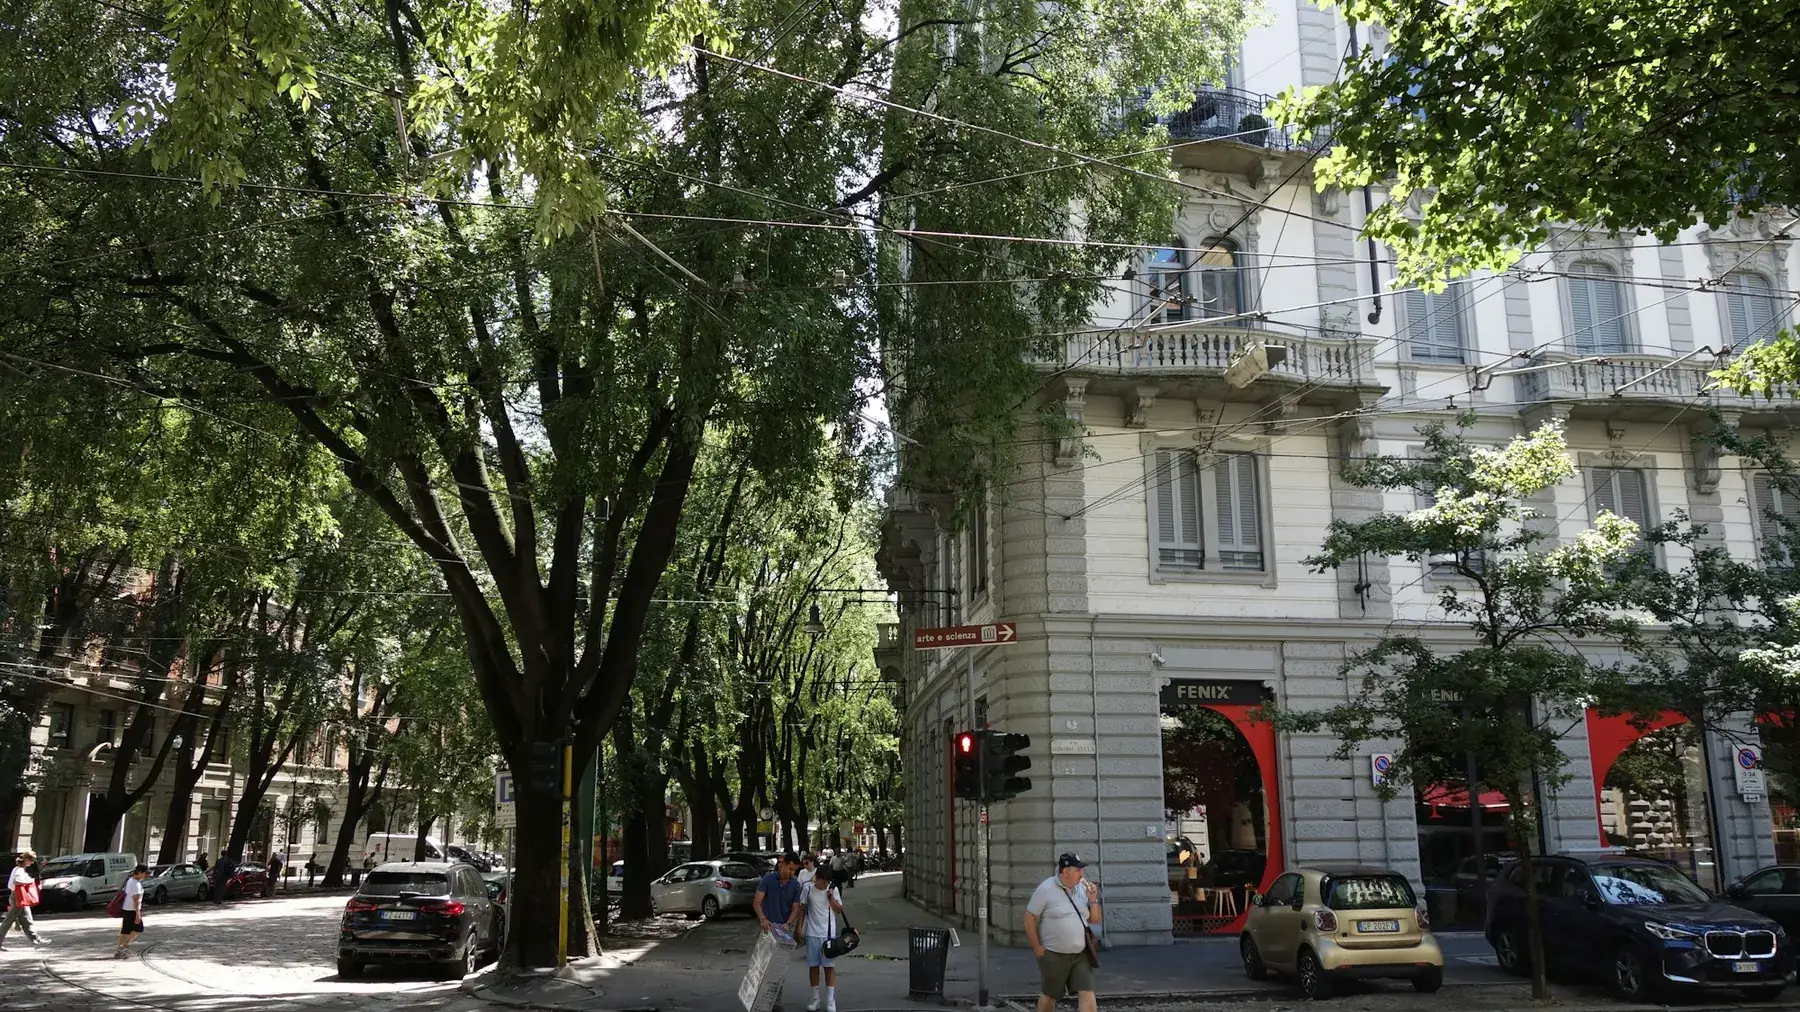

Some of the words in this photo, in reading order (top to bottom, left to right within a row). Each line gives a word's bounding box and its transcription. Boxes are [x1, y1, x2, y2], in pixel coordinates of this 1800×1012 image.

[917, 634, 934, 643] arte
[945, 631, 976, 641] scienza
[1177, 685, 1230, 699] FENIX
